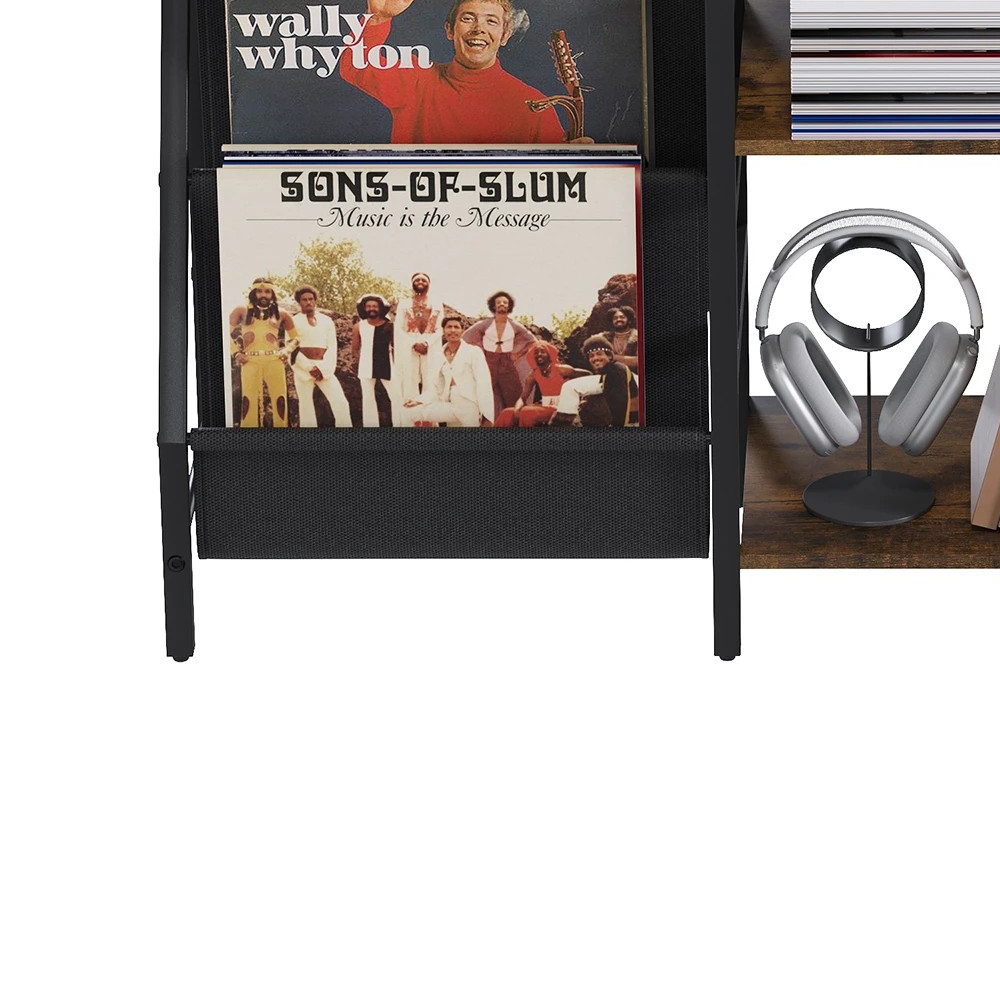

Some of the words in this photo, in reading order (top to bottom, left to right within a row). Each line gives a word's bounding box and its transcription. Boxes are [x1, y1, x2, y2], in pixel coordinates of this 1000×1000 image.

[234, 5, 374, 46] wally
[236, 37, 433, 78] whyton
[281, 171, 588, 203] SONS-OF-SLUM
[316, 207, 393, 229] Music
[399, 207, 414, 228] is
[421, 207, 450, 228] the
[455, 207, 551, 231] Message
